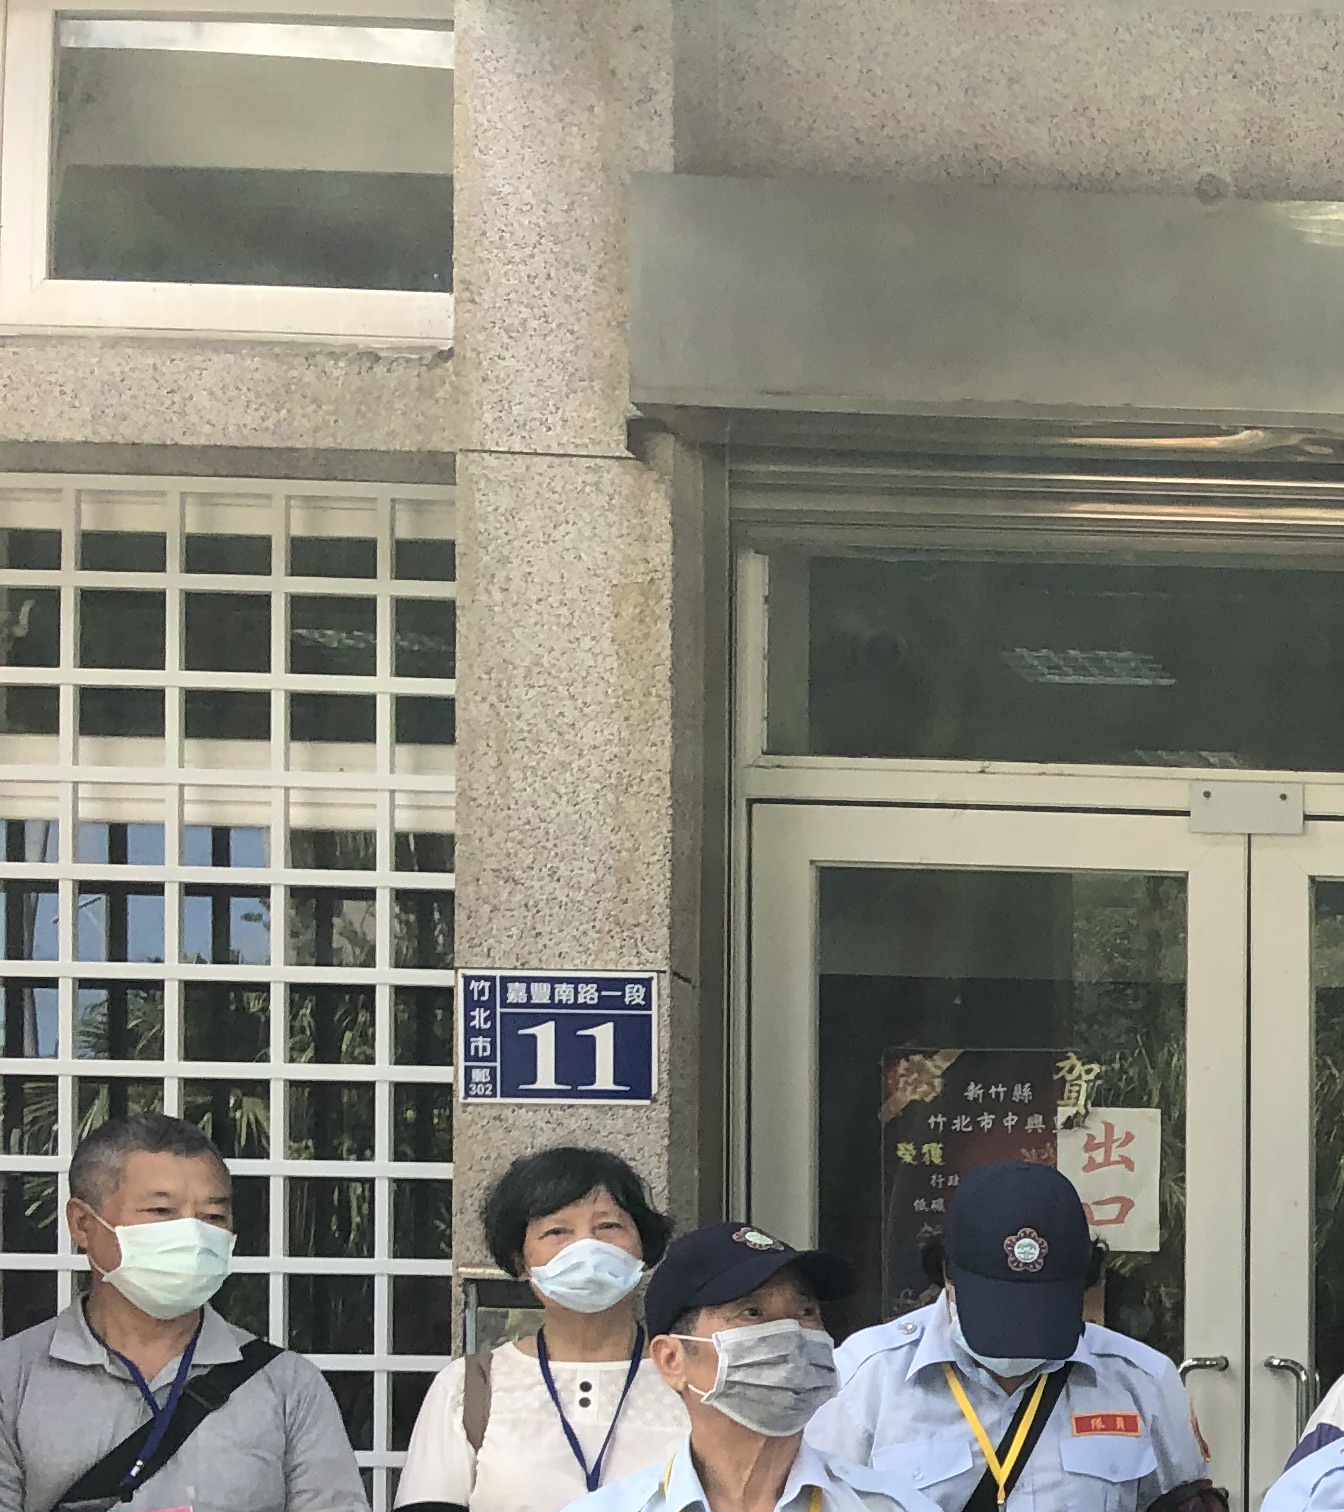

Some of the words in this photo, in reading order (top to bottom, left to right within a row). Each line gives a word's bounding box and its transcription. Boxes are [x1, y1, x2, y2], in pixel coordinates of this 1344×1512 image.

[506, 982, 646, 1006] 嘉豐南路一段
[469, 979, 492, 1058] 竹北市
[517, 1020, 631, 1092] 11
[468, 1083, 493, 1096] 302
[963, 1080, 1034, 1104] 新竹縣
[1082, 1120, 1136, 1227] 出口
